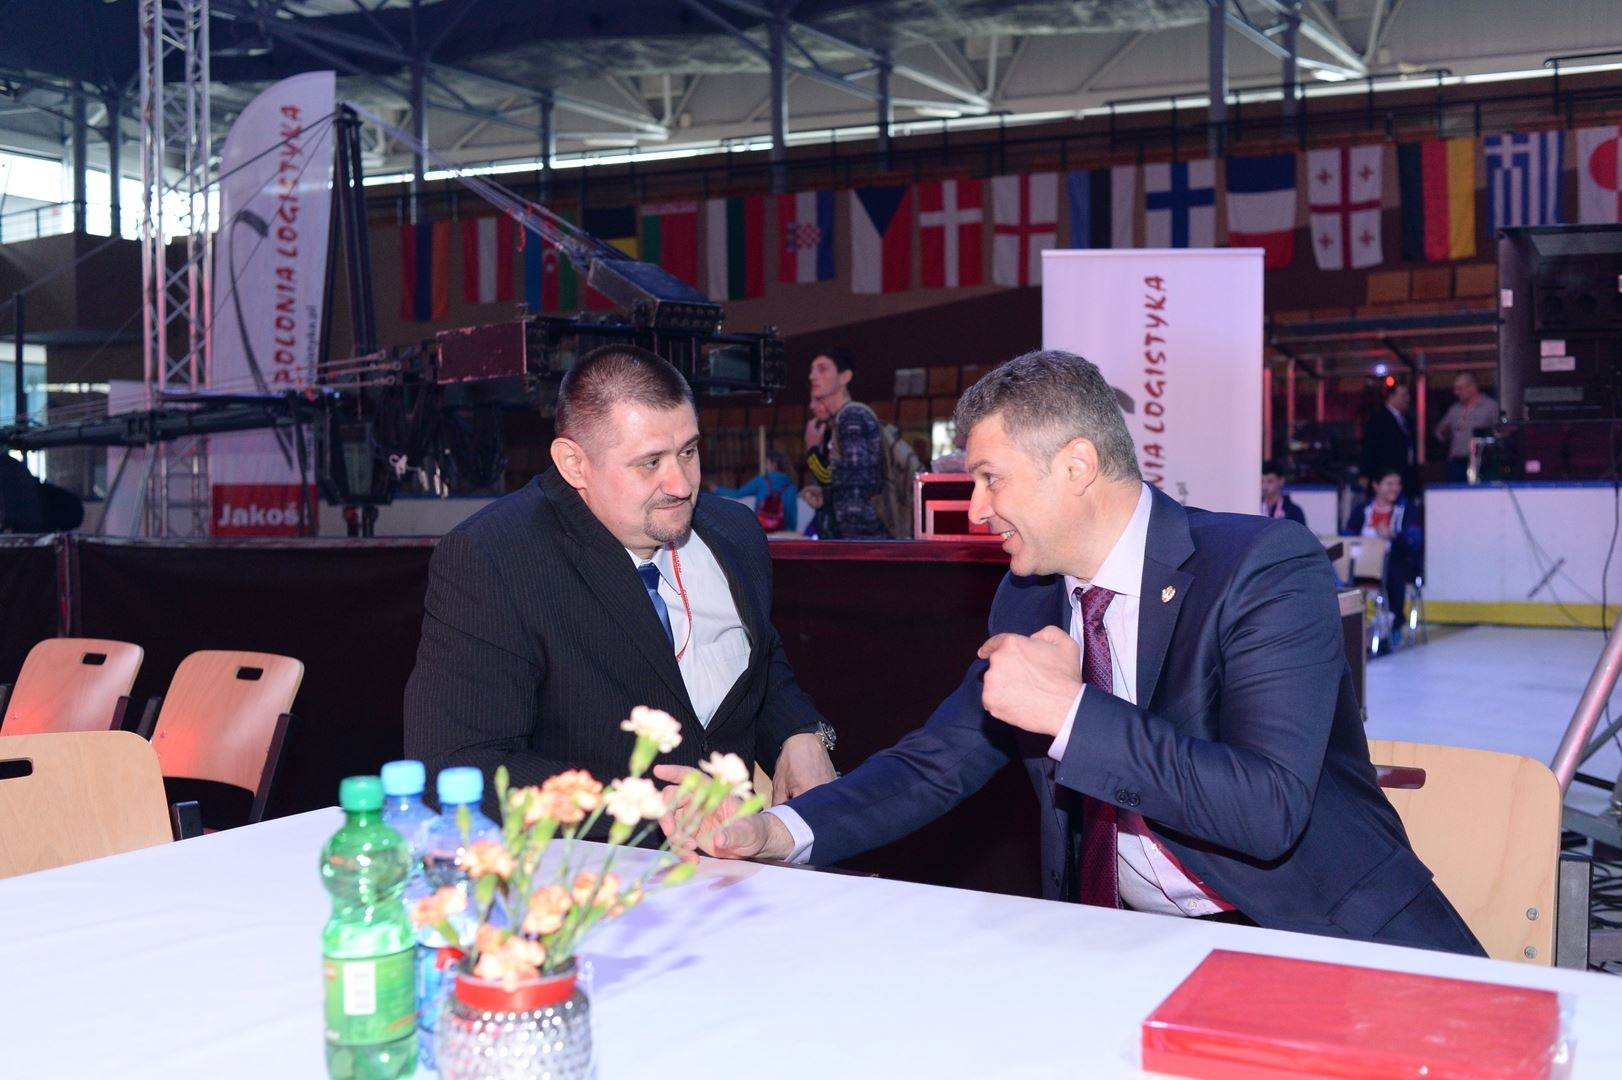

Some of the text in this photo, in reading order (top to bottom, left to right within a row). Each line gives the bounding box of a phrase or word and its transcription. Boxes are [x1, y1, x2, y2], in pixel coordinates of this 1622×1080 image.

[273, 266, 297, 385] POLONIA
[1143, 275, 1169, 489] NIA LOGISTYKA
